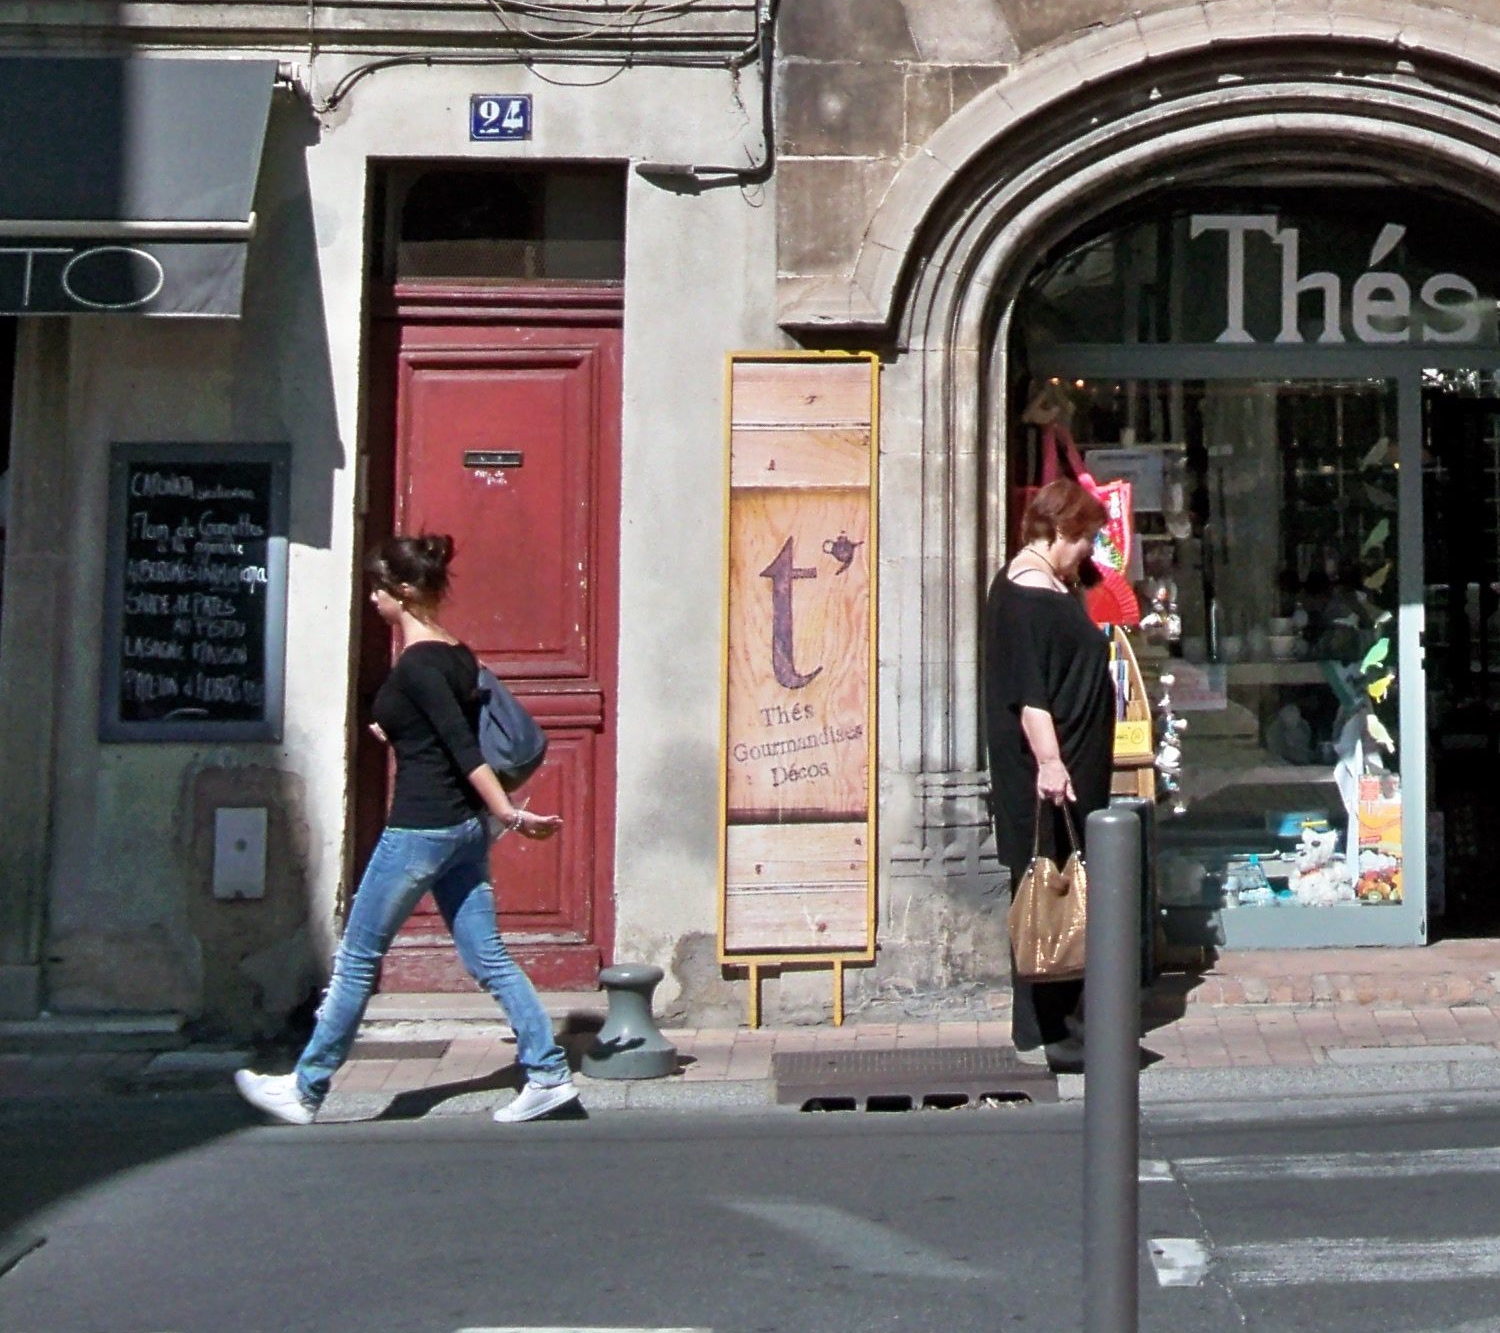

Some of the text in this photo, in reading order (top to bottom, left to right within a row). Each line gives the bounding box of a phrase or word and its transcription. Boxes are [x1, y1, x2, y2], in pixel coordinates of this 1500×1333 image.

[479, 100, 524, 133] 24
[1190, 213, 1480, 343] Thés
[760, 702, 815, 727] Thés
[733, 724, 863, 762] Gourmandises
[770, 761, 830, 787] Décos
